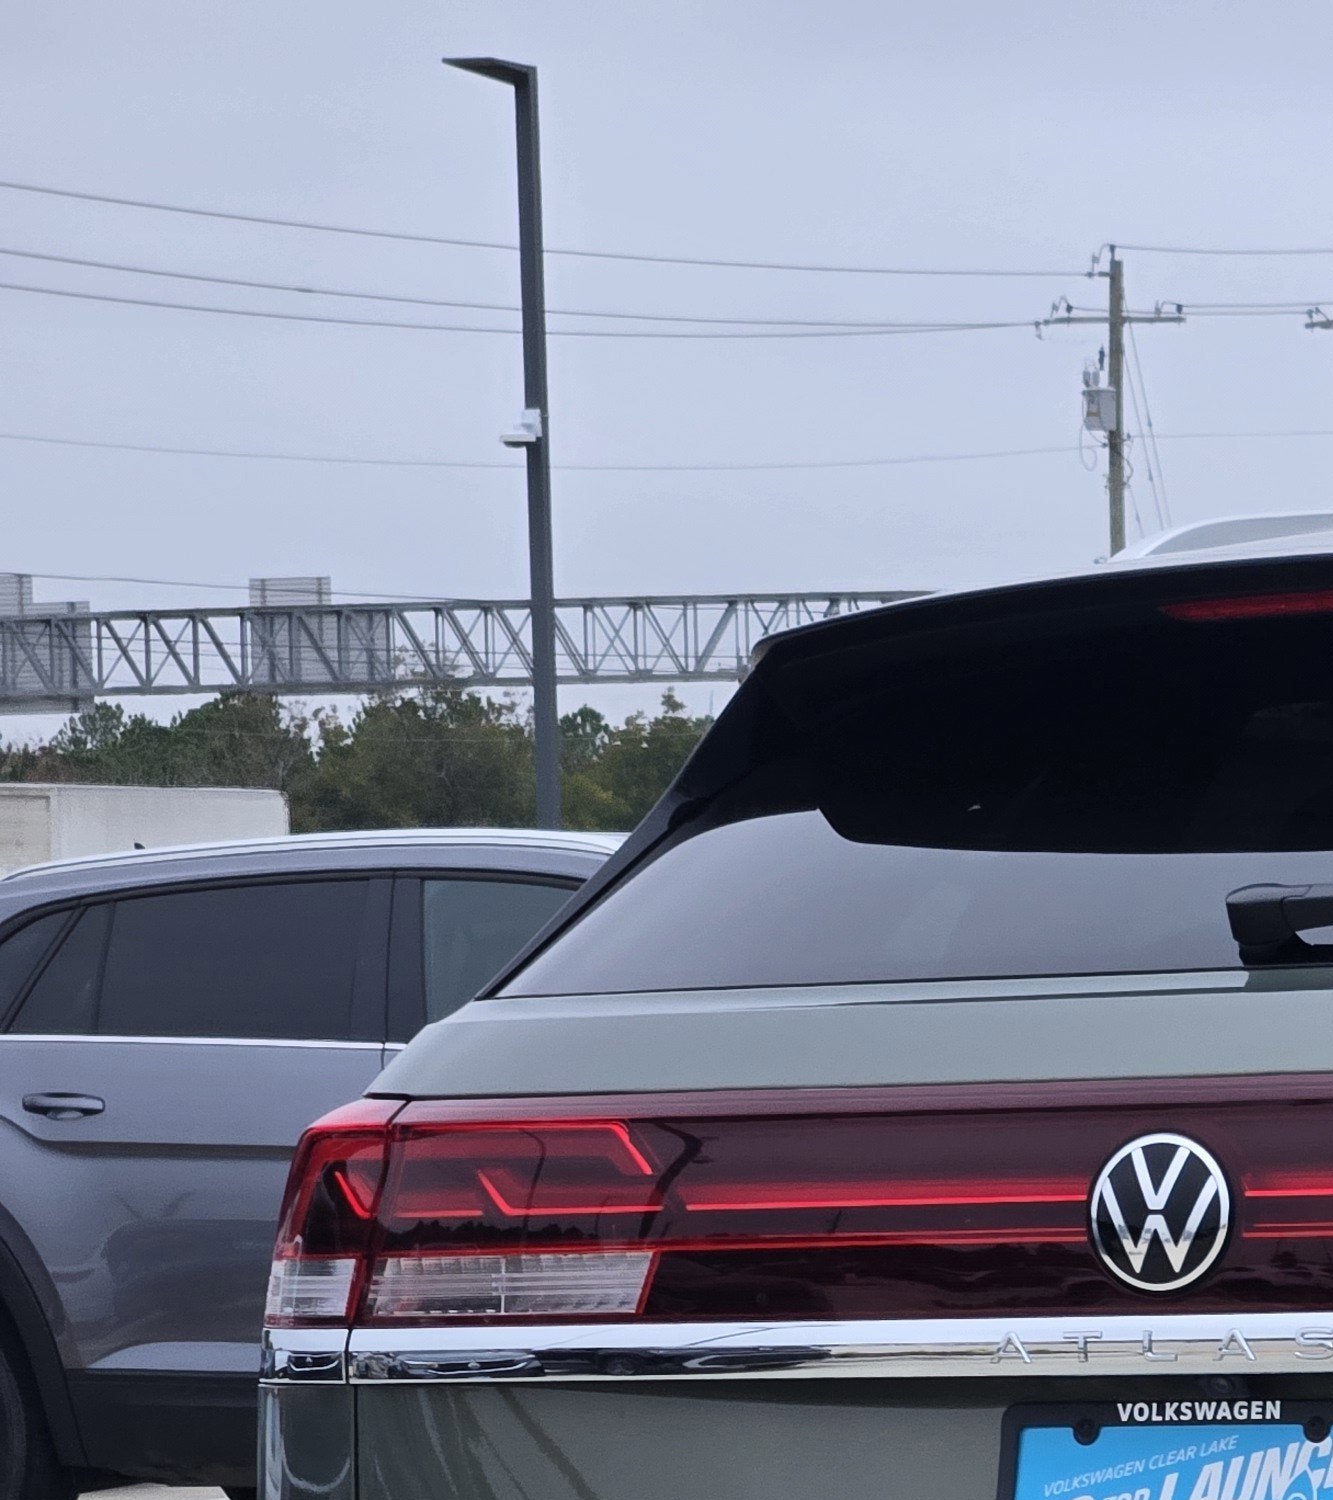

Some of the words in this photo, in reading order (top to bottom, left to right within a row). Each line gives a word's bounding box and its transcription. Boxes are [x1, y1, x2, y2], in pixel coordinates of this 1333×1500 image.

[1117, 1400, 1281, 1421] VOLKSWAGEN
[1044, 1459, 1145, 1497] VOLKSWAGEN
[1149, 1445, 1197, 1470] CLEAR
[1200, 1435, 1239, 1457] LAKE
